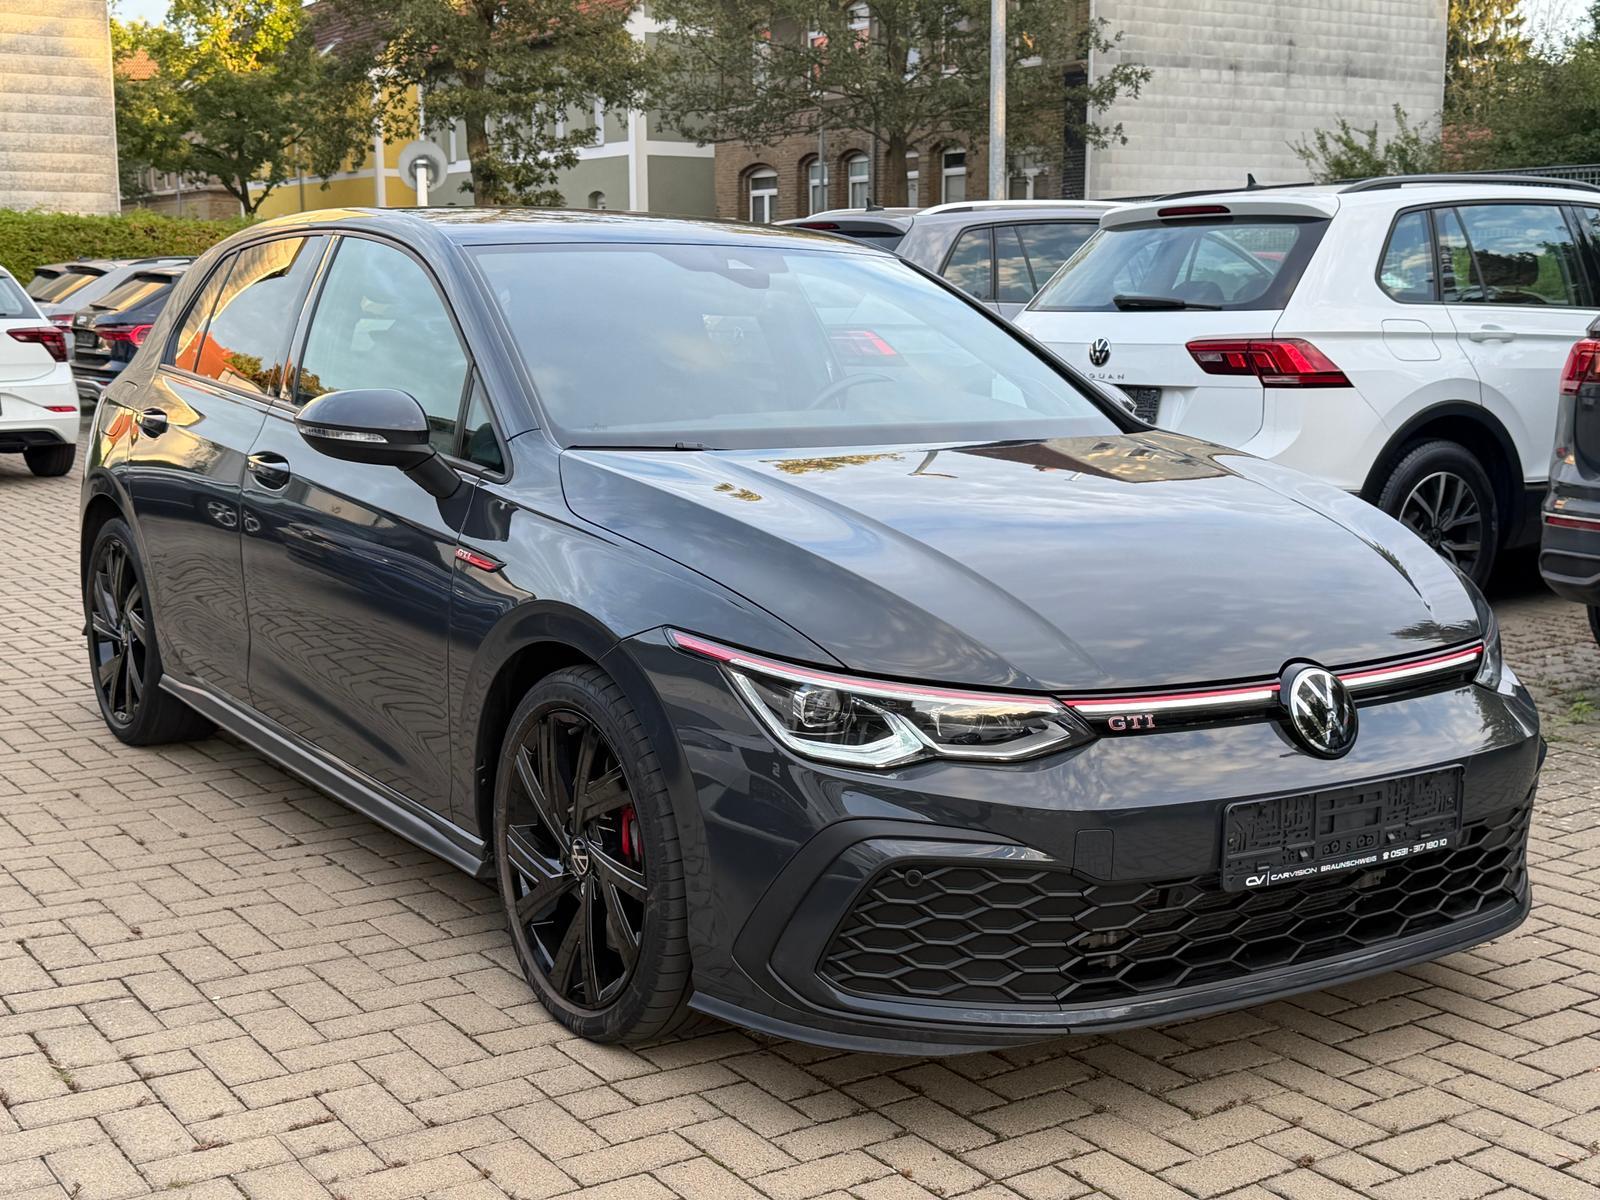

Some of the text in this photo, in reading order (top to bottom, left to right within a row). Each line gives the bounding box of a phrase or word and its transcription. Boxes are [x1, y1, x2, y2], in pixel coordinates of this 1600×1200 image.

[456, 548, 472, 560] GTI
[1108, 713, 1156, 730] GTI
[1245, 875, 1266, 886] CV
[1270, 867, 1318, 881] CARVISION
[1320, 855, 1377, 872] BRAUNSCHWEIG
[1390, 847, 1409, 858] 0531
[1413, 843, 1425, 853] 317
[1426, 840, 1439, 850] 180
[1439, 838, 1448, 846] 10
